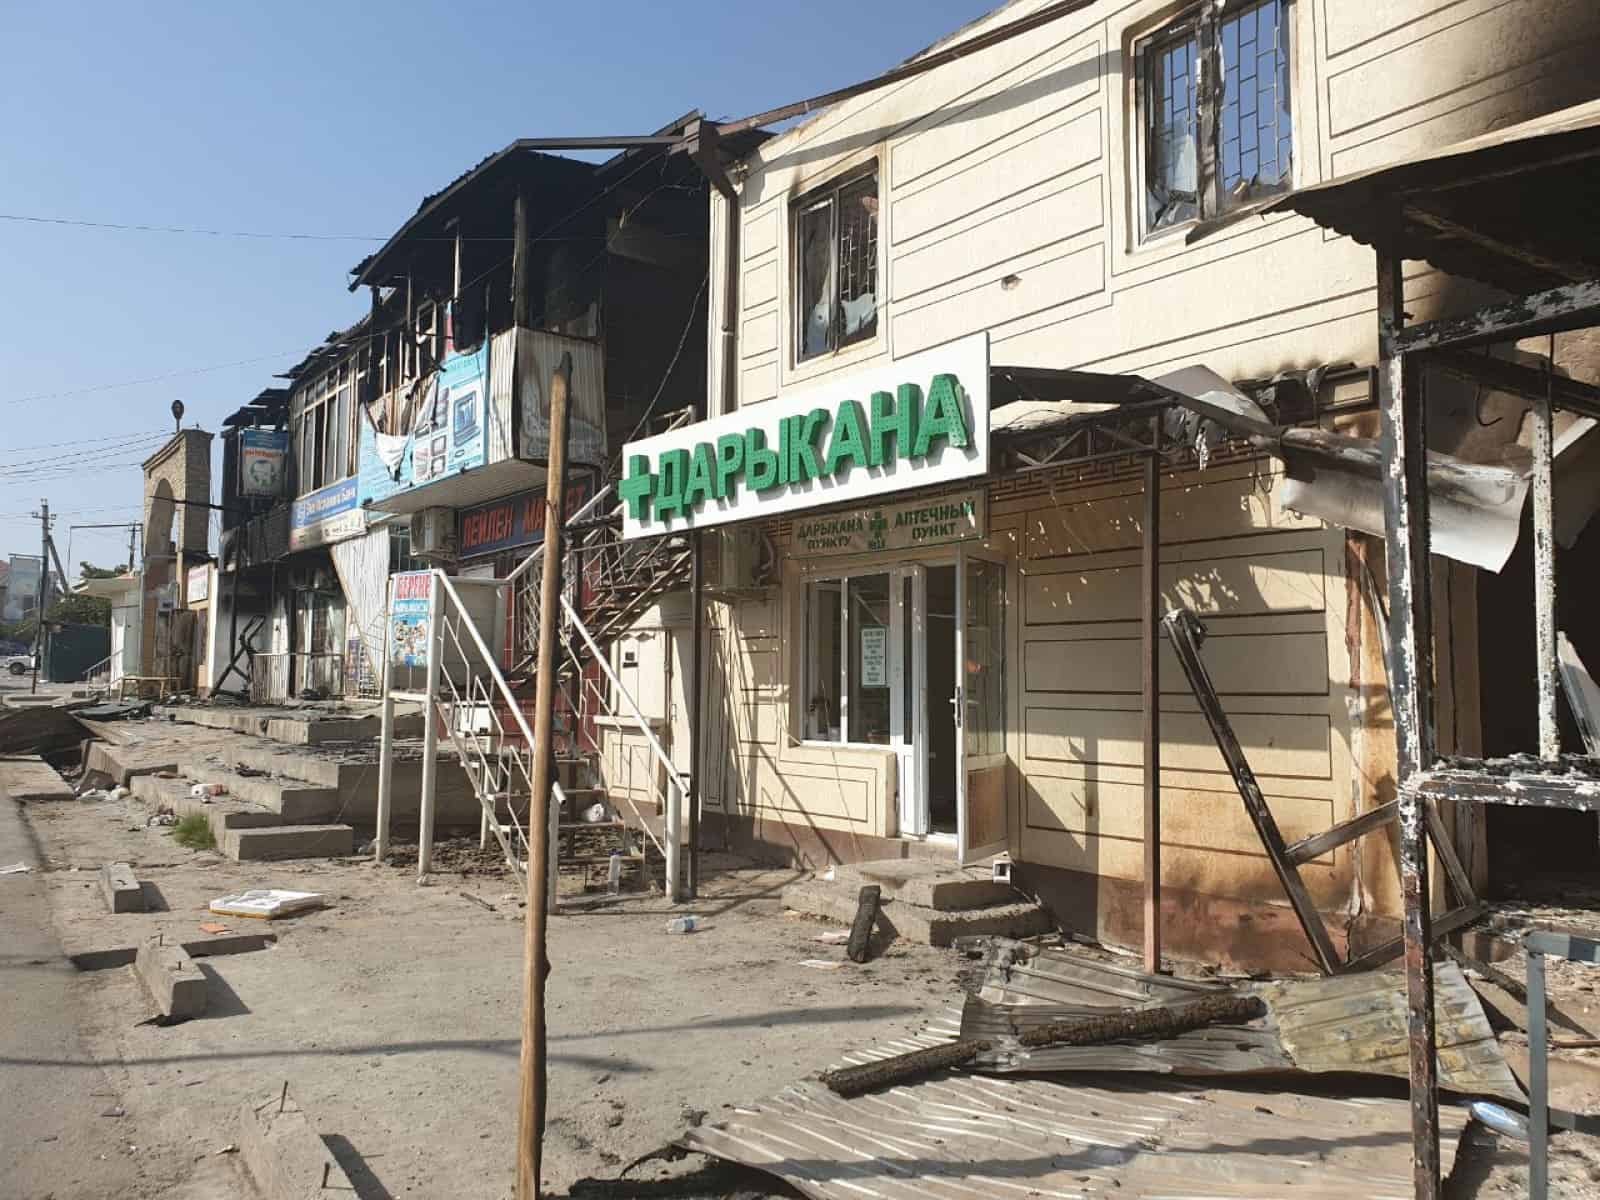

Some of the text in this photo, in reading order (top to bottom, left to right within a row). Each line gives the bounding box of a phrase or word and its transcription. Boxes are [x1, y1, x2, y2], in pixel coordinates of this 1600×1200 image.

[654, 373, 969, 522] ДАРЫКАНА
[912, 523, 955, 540] ПУНКТ
[807, 535, 851, 550] ПУНКТУ
